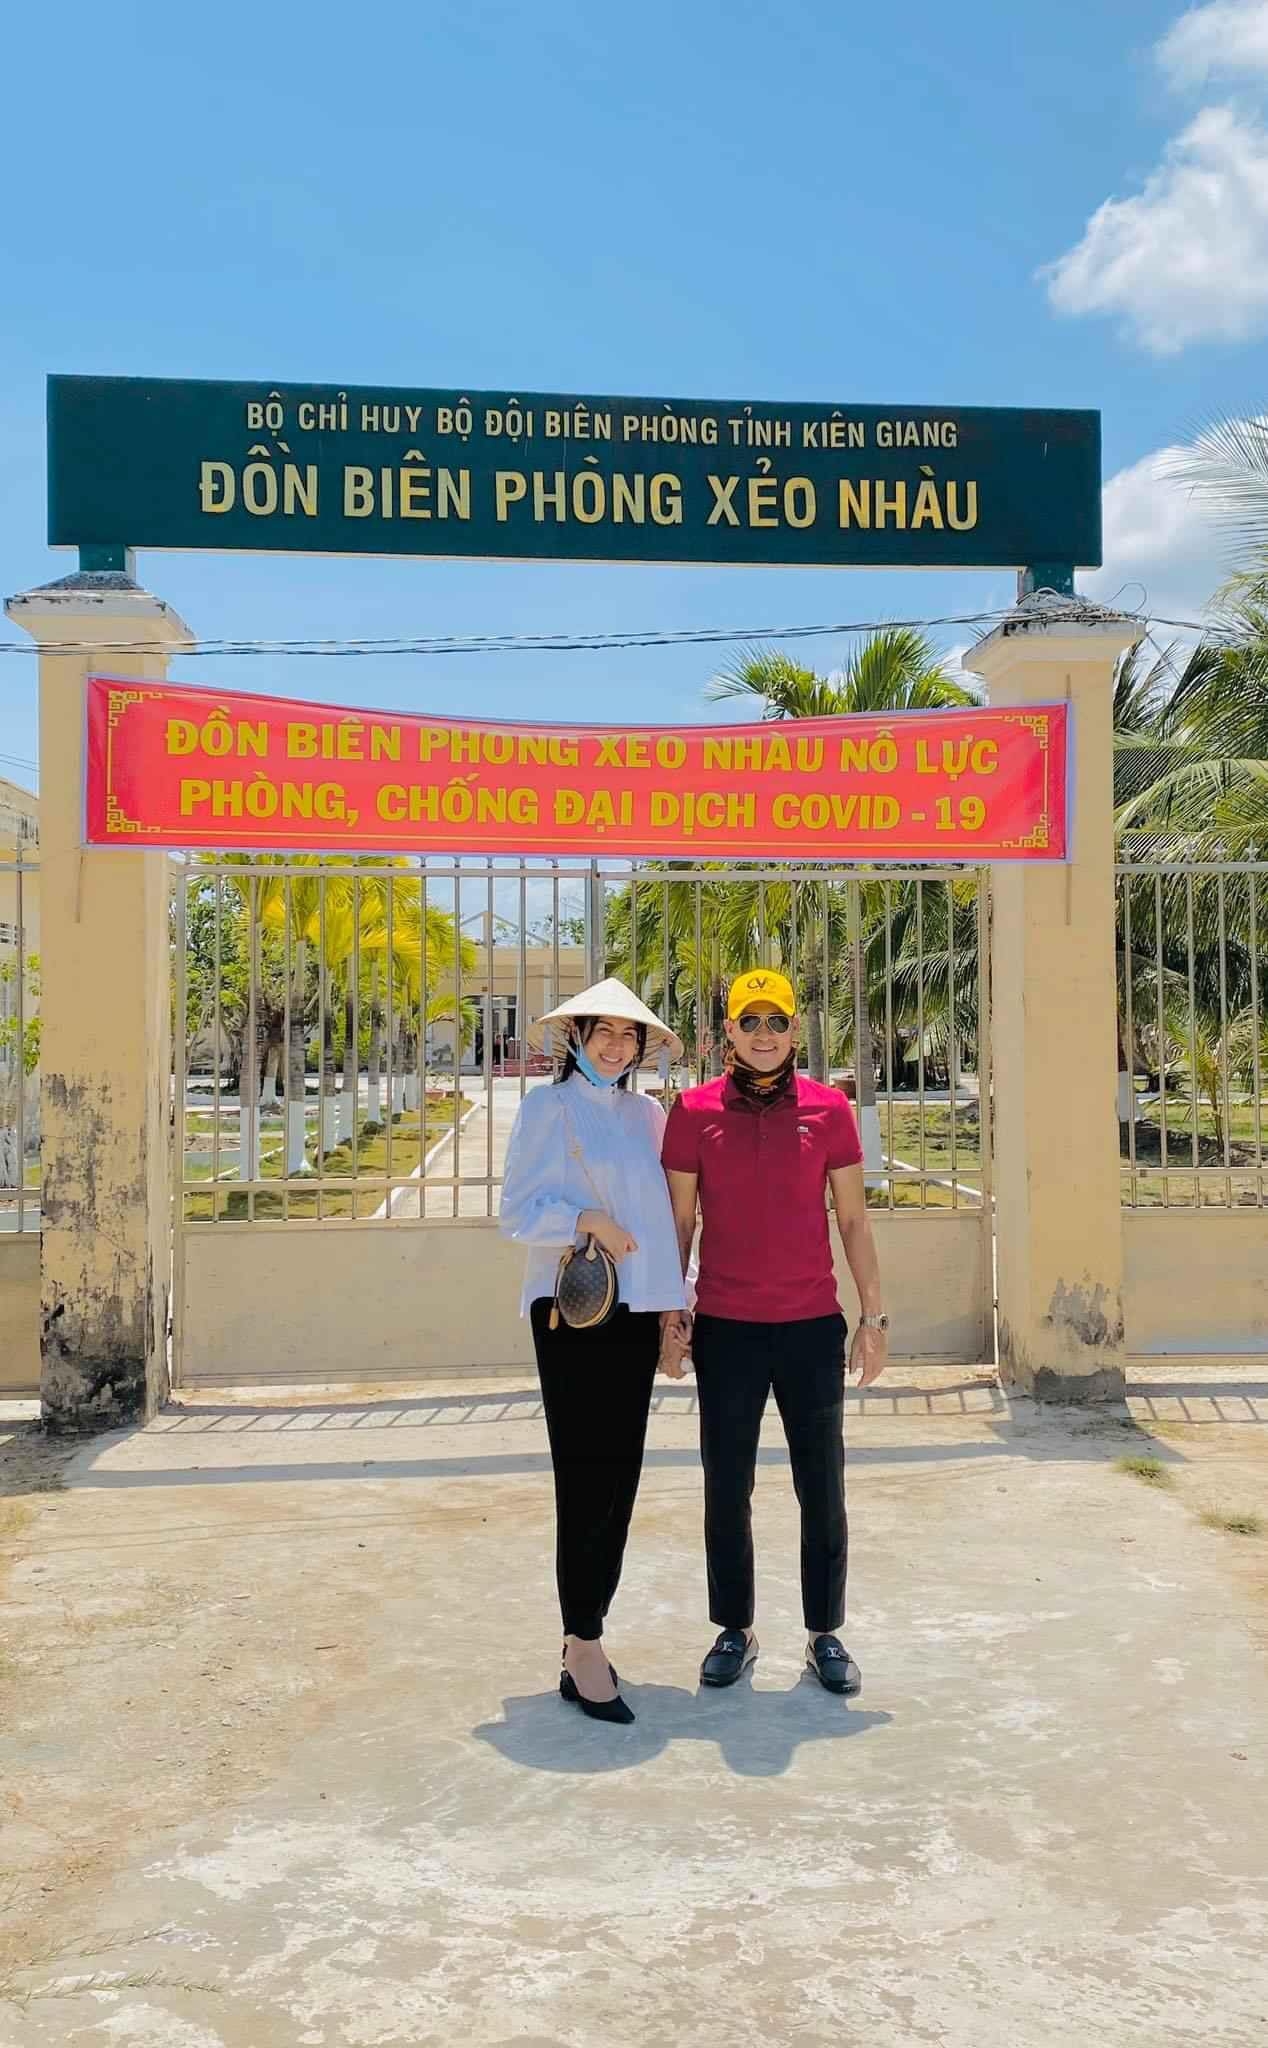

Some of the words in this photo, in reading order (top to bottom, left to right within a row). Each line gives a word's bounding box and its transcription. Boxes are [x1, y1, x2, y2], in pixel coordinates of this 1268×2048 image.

[247, 391, 284, 436] BỘ
[298, 391, 348, 431] CHỈ
[362, 404, 422, 433] HUY
[437, 397, 473, 442] BỘ
[484, 398, 533, 443] ĐỘI
[545, 402, 611, 440] BIÊN
[623, 404, 718, 445] PHÒNG
[728, 406, 791, 447] TỈNH
[803, 411, 865, 448] KIÊN
[876, 420, 957, 448] GIANG
[199, 443, 318, 516] ĐỒN
[344, 449, 471, 520] BIÊN
[495, 455, 683, 525] PHÒNG
[707, 457, 817, 528] XẺO
[839, 465, 978, 530] NHÀU
[165, 705, 269, 757] ĐỒN
[287, 716, 401, 761] BIÊN
[702, 731, 824, 773] NHÀU
[915, 734, 998, 781] LỰC
[181, 771, 360, 828] PHÒNG,
[377, 772, 539, 825] CHỐNG
[553, 788, 633, 833] ĐẠI
[650, 791, 756, 836] DỊCH
[773, 793, 901, 830] COVID
[935, 795, 986, 831] 19
